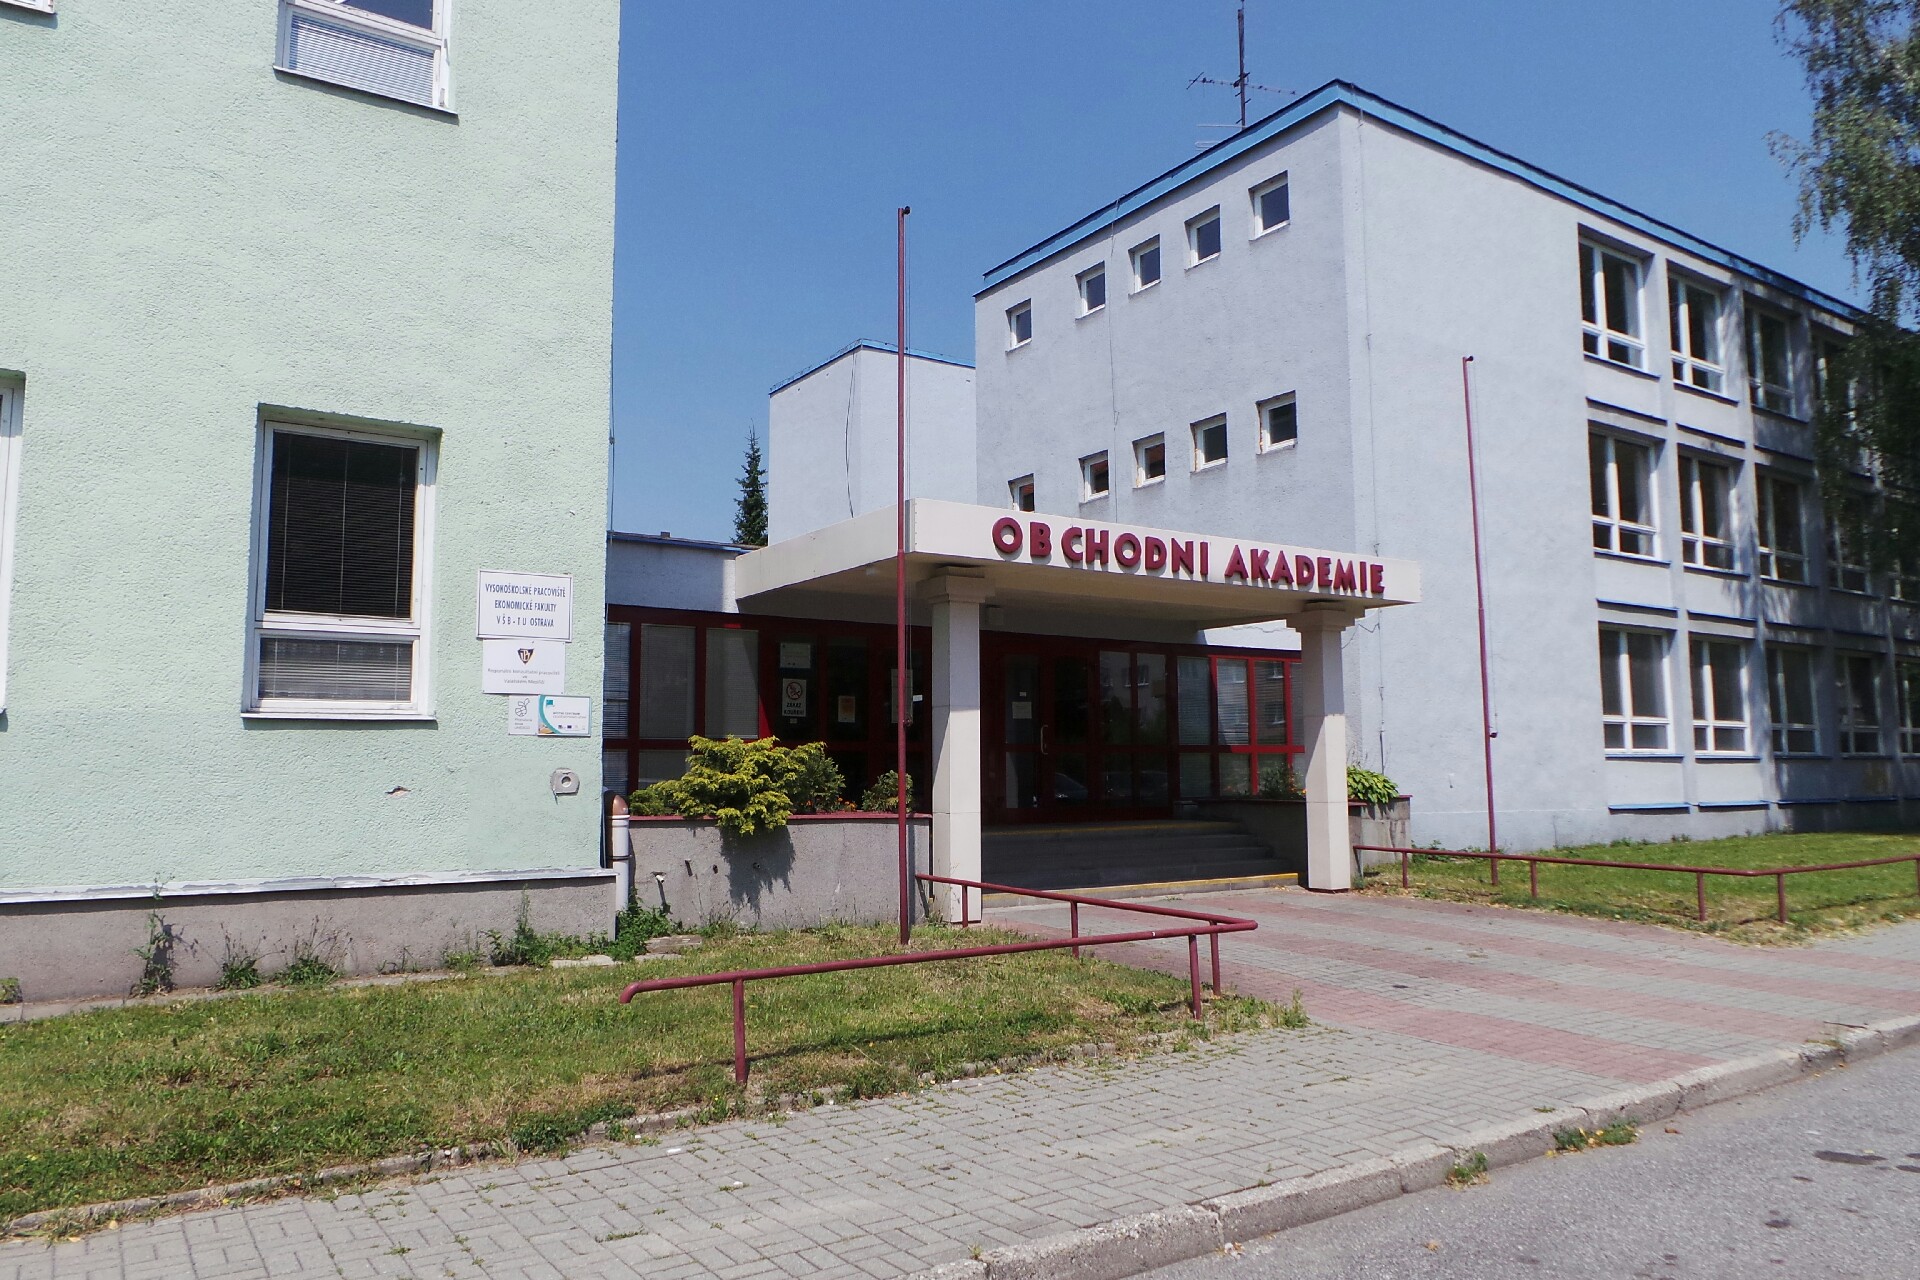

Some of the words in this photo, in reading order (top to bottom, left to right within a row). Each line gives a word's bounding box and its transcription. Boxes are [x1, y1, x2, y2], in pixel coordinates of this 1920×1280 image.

[992, 516, 1209, 577] OBCHODNI
[1224, 544, 1385, 593] AKADEMIE
[485, 583, 532, 595] VYSOKOŠKOLSKÉ
[533, 586, 566, 598] PRACOVIŠTĚ
[494, 599, 533, 611] EKONOMICKÉ
[534, 602, 557, 612] FAKULTY
[529, 617, 555, 628] OSTRAVA
